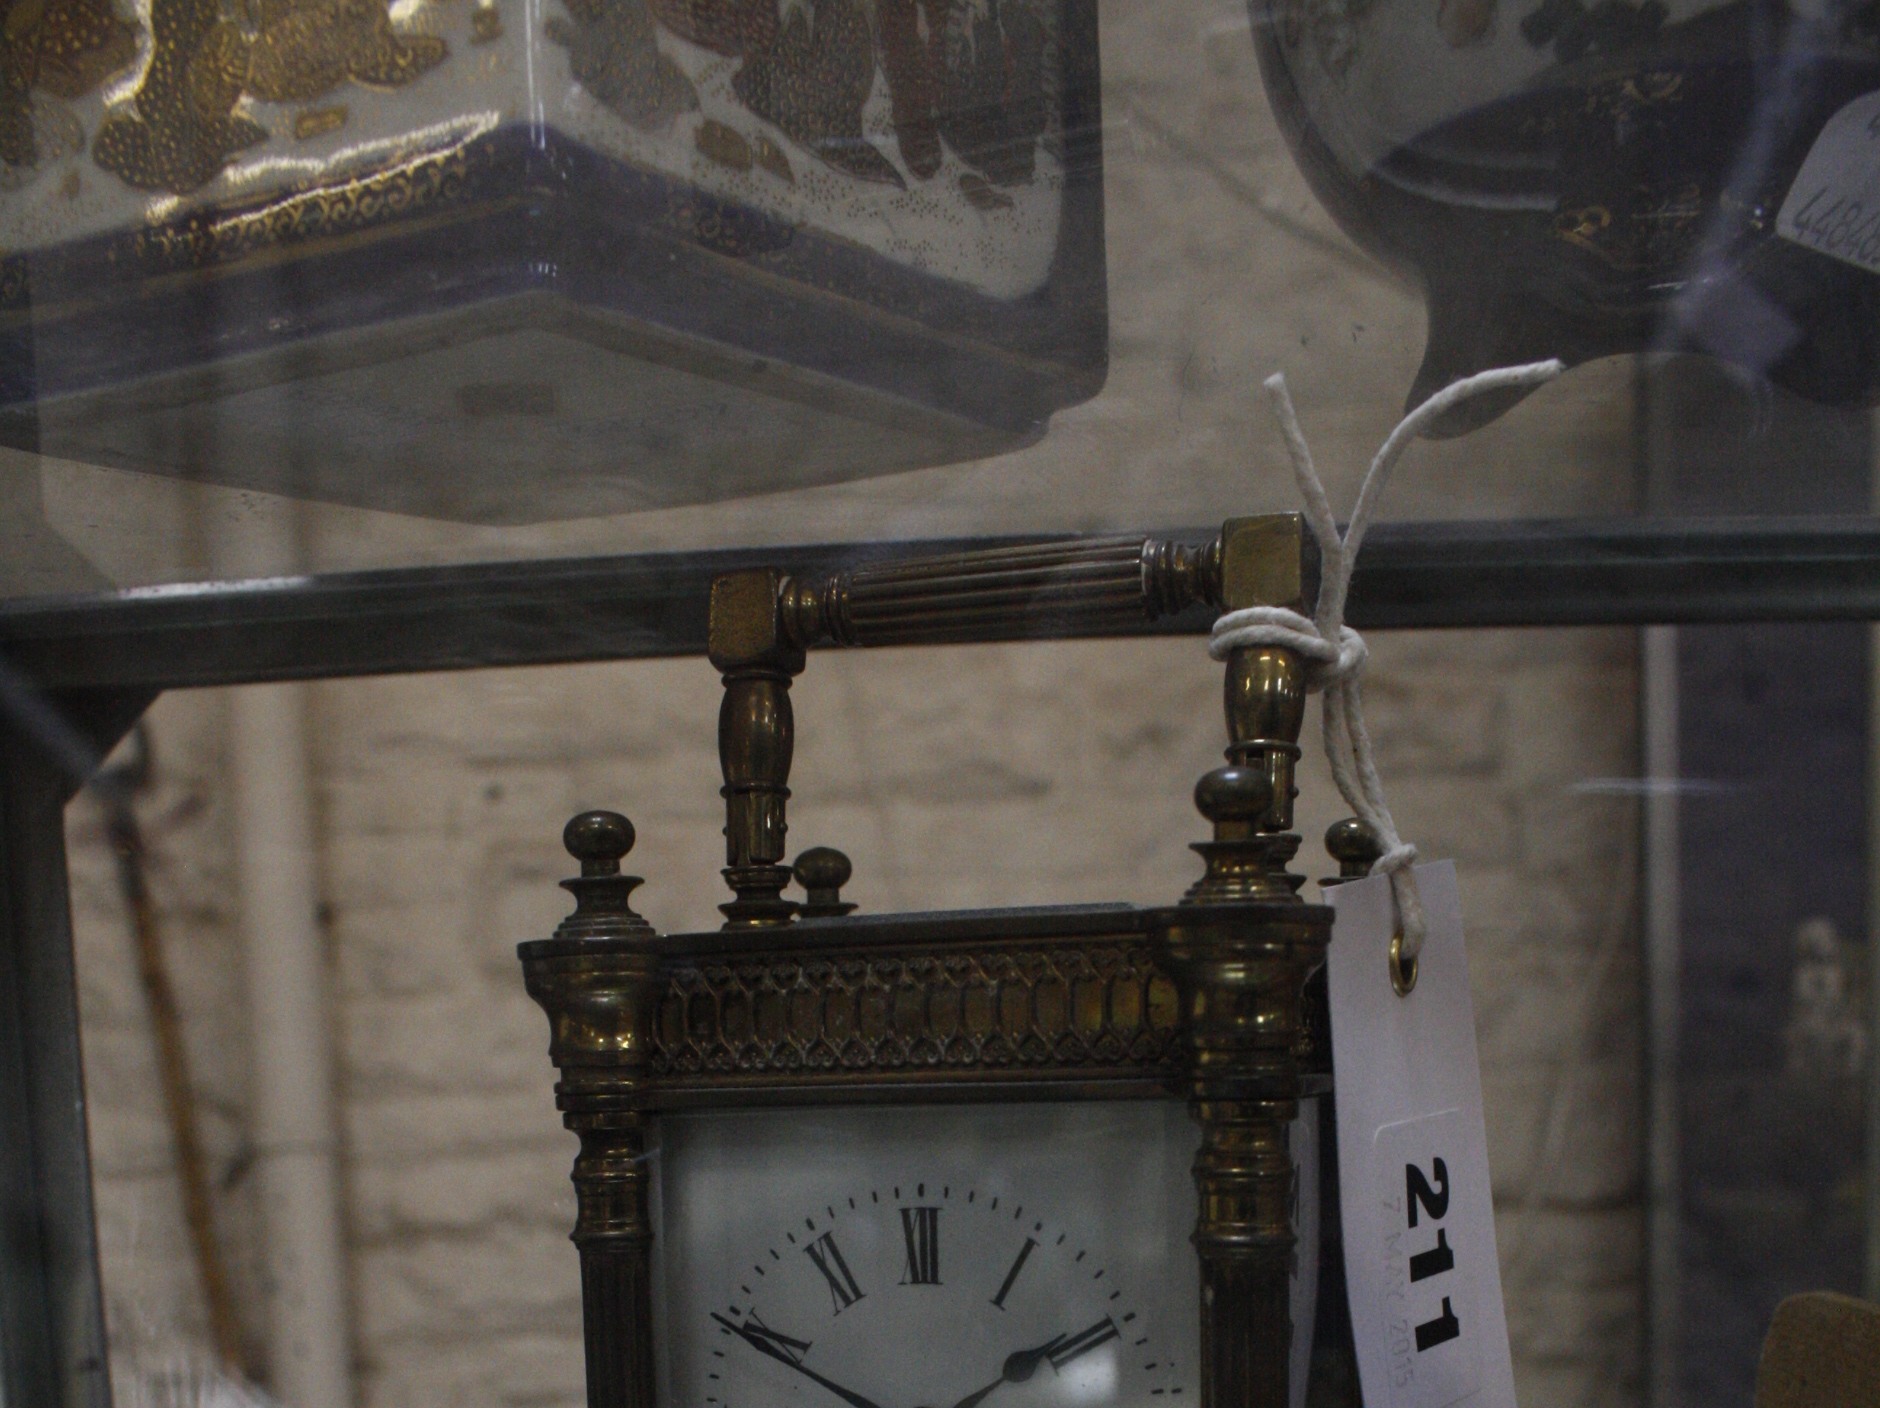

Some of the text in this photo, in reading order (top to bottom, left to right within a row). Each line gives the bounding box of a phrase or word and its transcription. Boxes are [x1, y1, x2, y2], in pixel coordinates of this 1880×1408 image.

[898, 1206, 943, 1286] XII
[1406, 1157, 1460, 1353] 211
[1389, 1319, 1415, 1389] 2015
